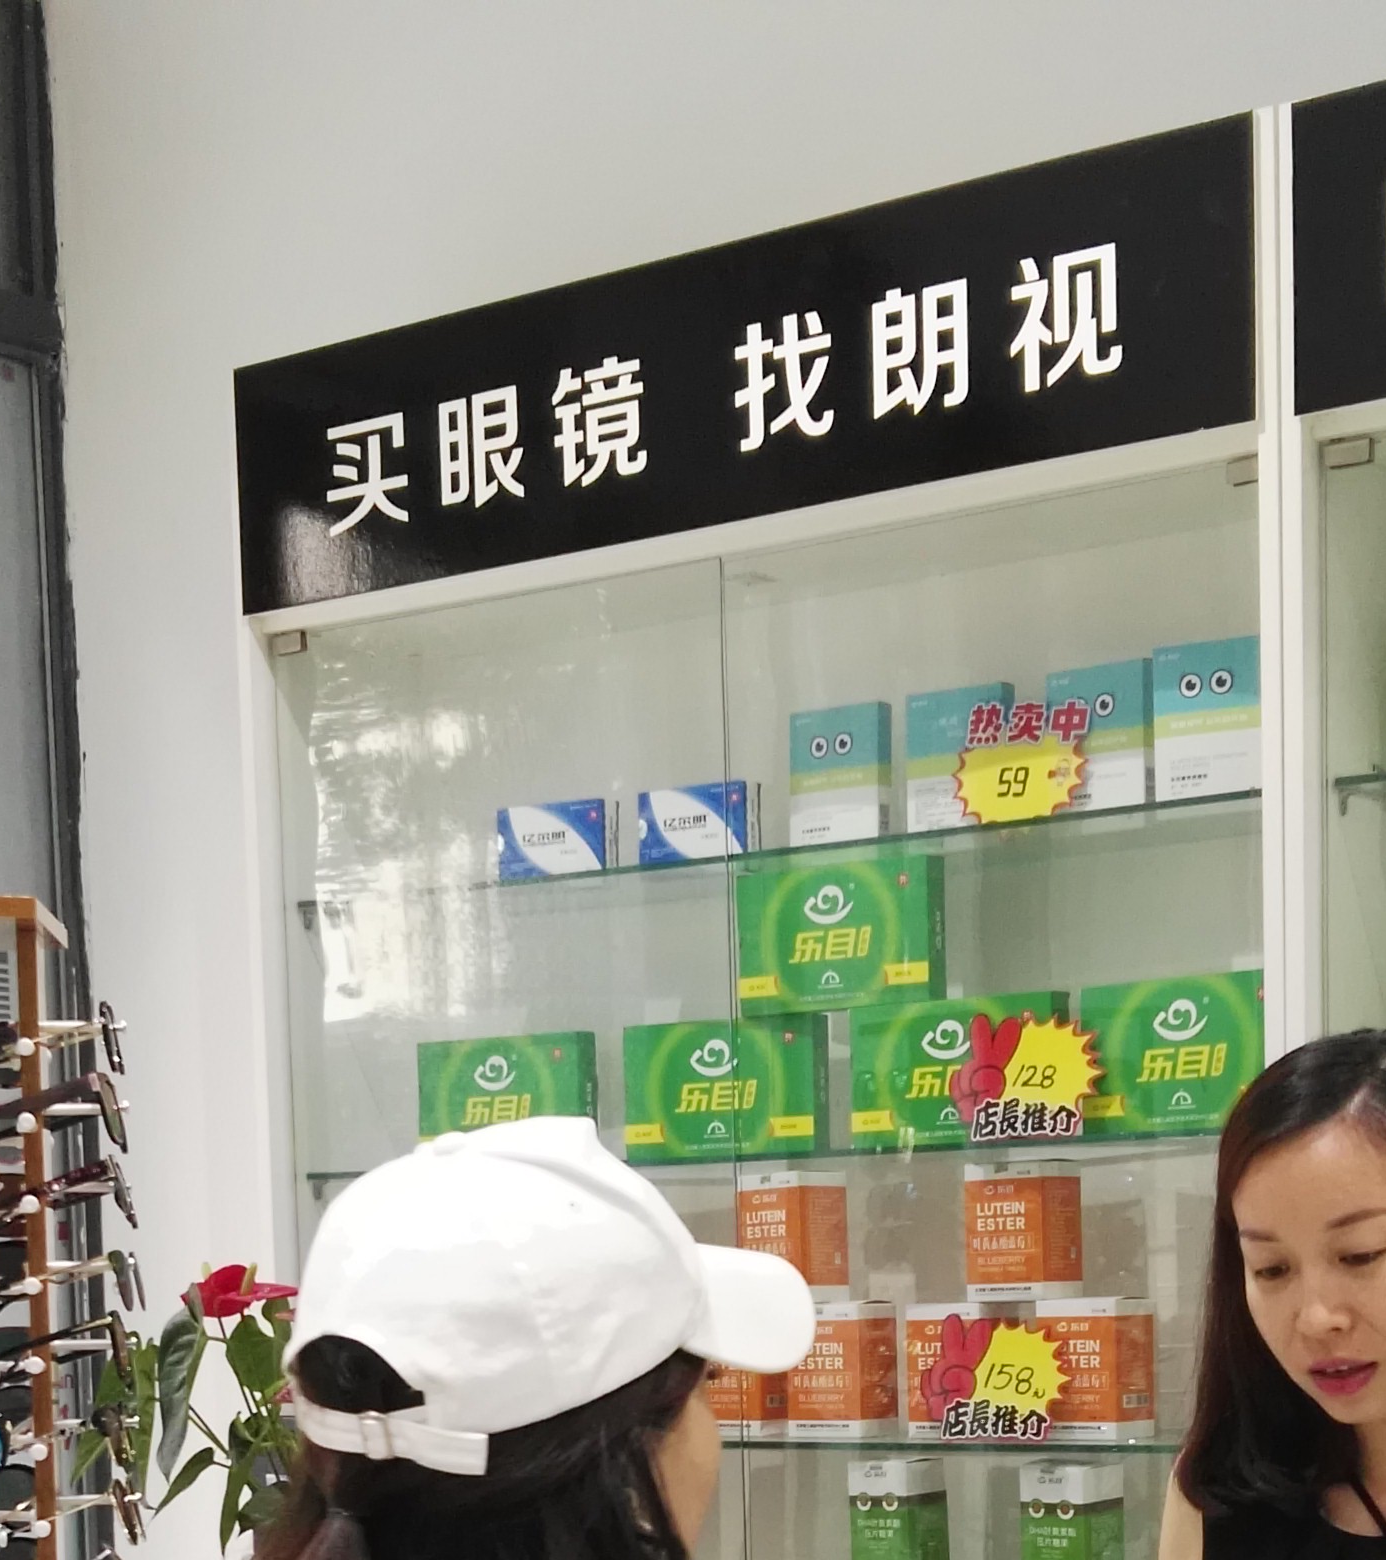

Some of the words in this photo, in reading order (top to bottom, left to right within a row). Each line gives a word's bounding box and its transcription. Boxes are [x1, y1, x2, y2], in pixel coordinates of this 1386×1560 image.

[326, 355, 646, 537] 买眼镜
[735, 243, 1122, 451] 找朗视
[968, 701, 1089, 746] 热卖中
[997, 766, 1030, 797] 59
[1013, 1065, 1057, 1089] 128
[973, 1099, 1077, 1140] 店長推介
[977, 1201, 1025, 1216] LUTEIN
[746, 1210, 786, 1225] LUTEIN
[977, 1217, 1025, 1231] ESTER
[747, 1225, 786, 1239] ESTER
[808, 1343, 843, 1355] TEIN
[1063, 1340, 1100, 1353] TEIN
[1063, 1355, 1100, 1368] TER
[943, 1400, 1048, 1439] 店長推介
